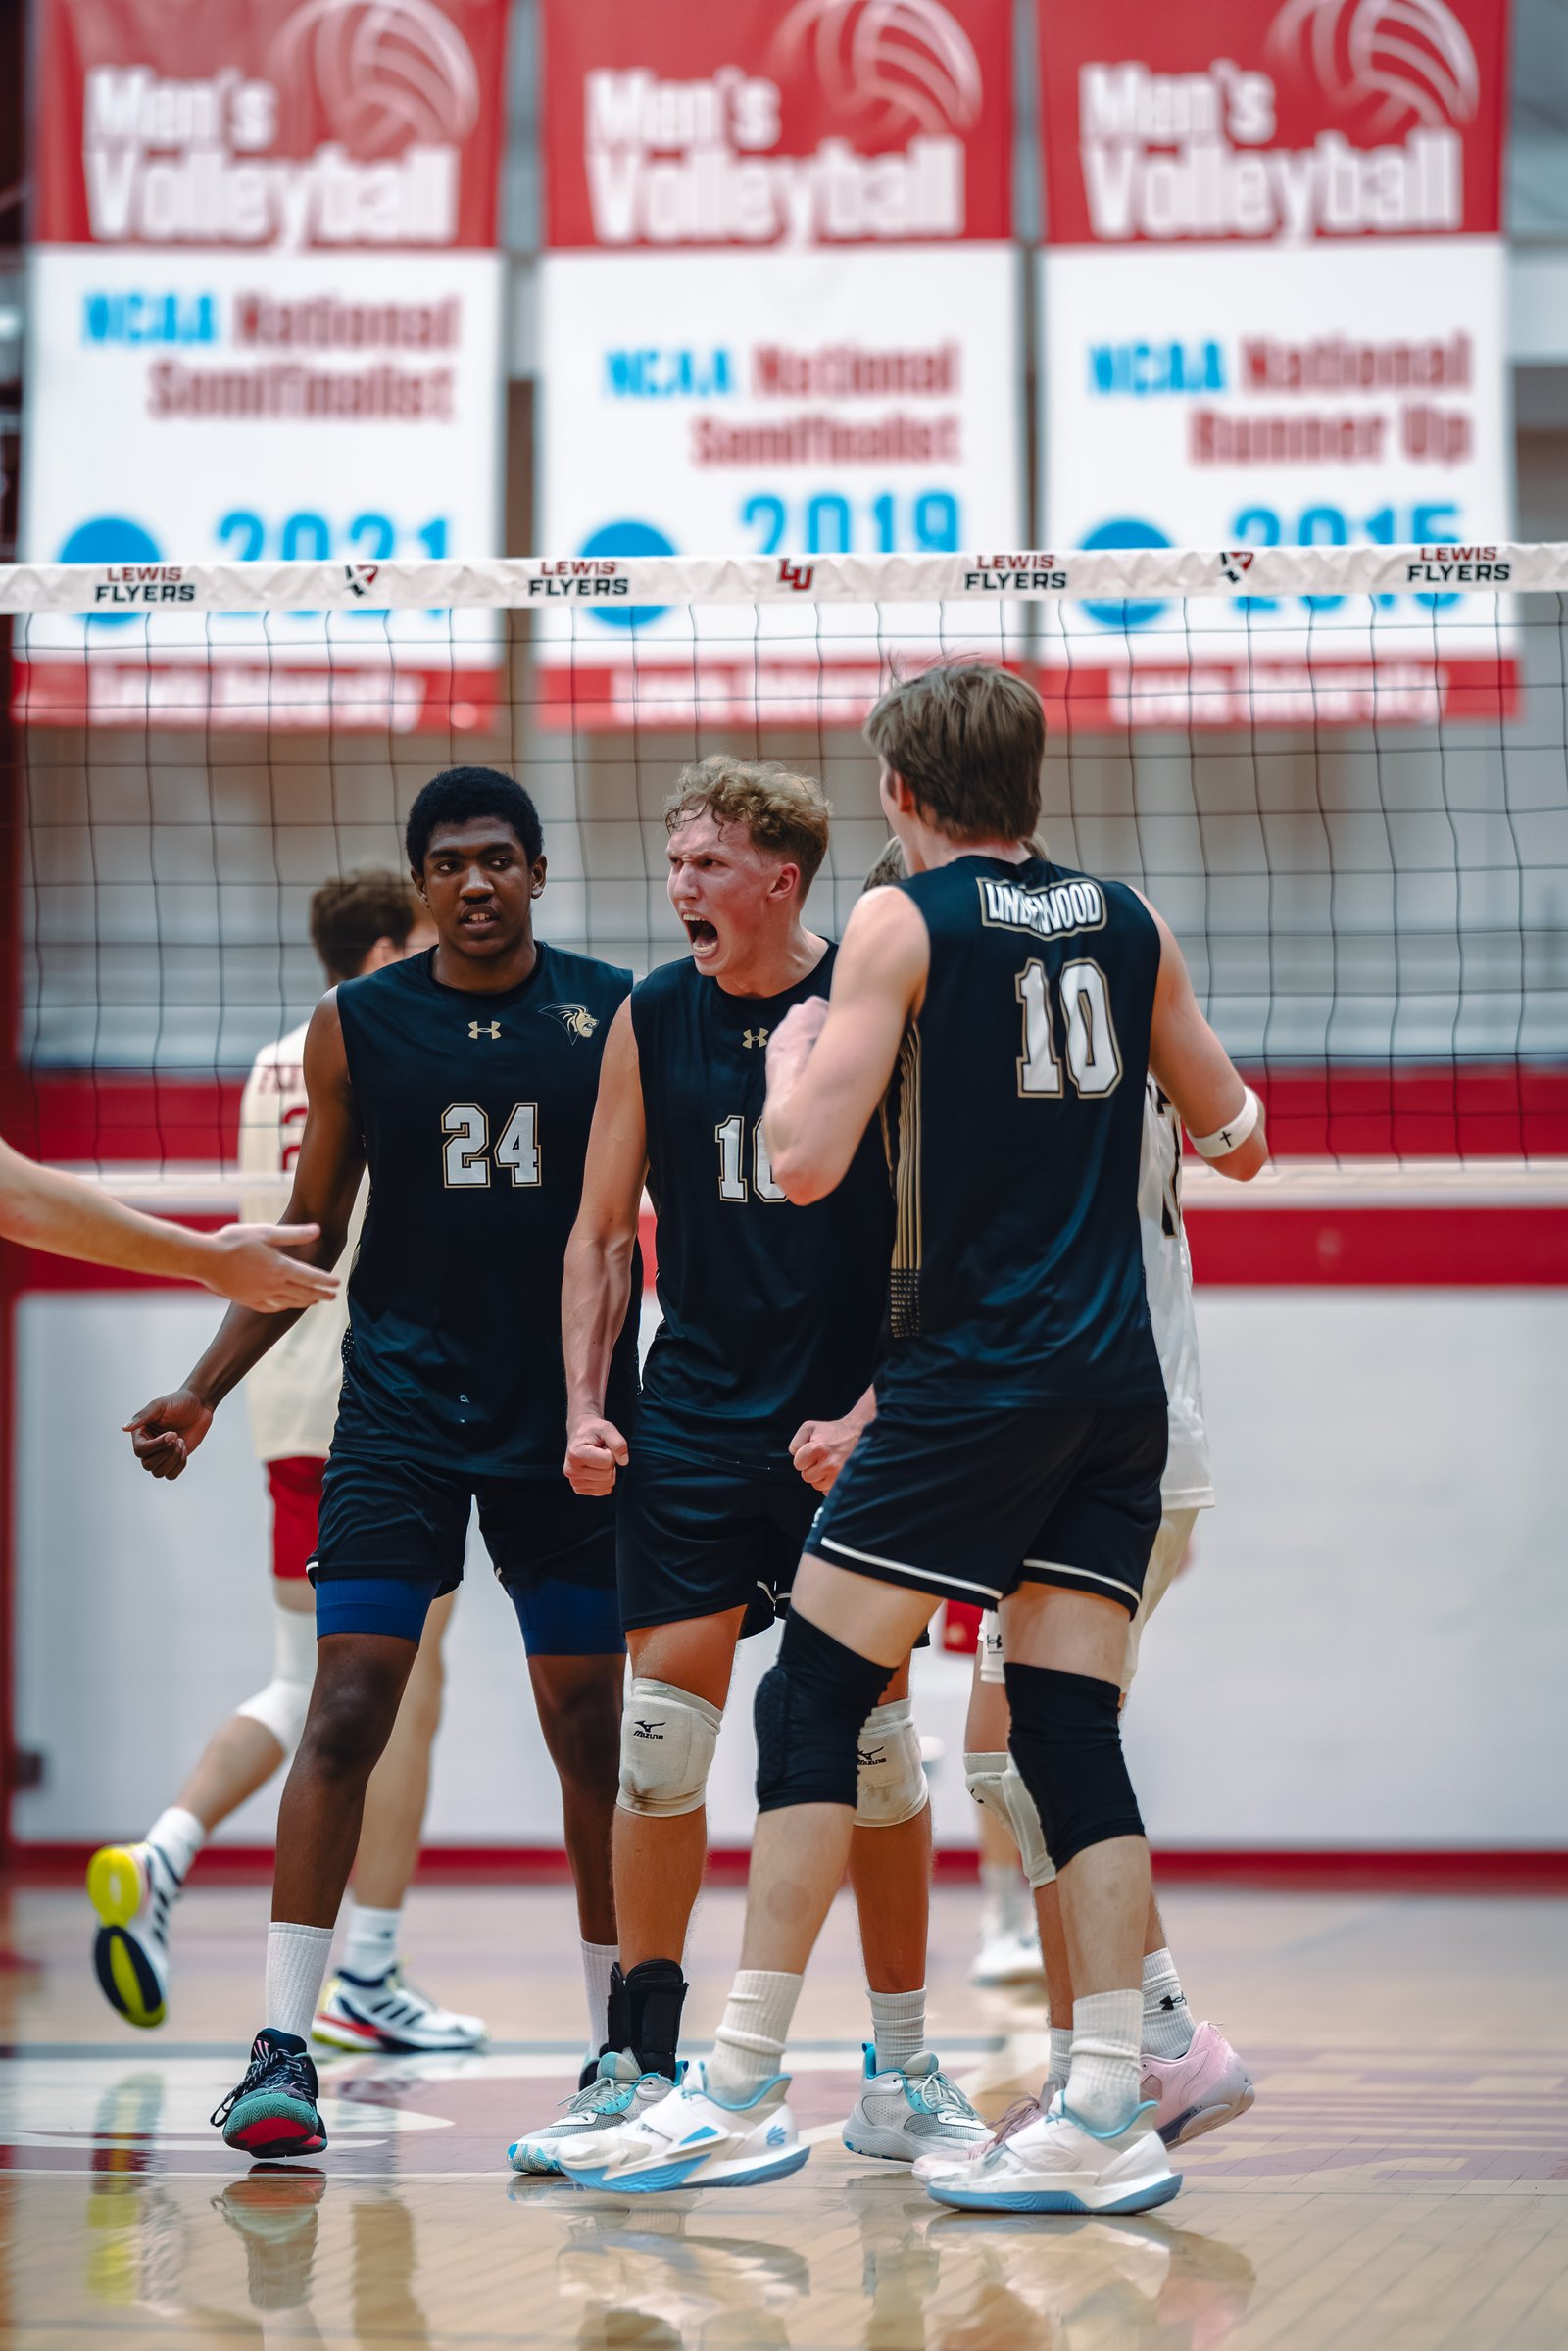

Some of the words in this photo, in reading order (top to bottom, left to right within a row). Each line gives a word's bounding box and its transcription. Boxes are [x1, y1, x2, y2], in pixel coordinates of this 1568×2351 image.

[85, 66, 275, 151] Men's
[586, 66, 782, 150] Men's
[1081, 61, 1274, 144] Men's
[85, 144, 459, 252] Volleyball
[586, 134, 966, 249] Volleyball
[1082, 128, 1462, 246] Volleyball
[82, 293, 218, 347] NCAA
[234, 296, 461, 351] National
[603, 346, 732, 398] NCAA
[752, 341, 960, 397] National
[1089, 339, 1224, 396] NCAA
[1241, 332, 1472, 392] National
[1188, 407, 1383, 466] Runner
[1399, 401, 1472, 468] Up
[107, 565, 182, 582] LEWIS
[540, 561, 617, 576] LEWIS
[777, 558, 815, 592] LU
[964, 572, 1067, 591] FLYERS
[976, 555, 1055, 570] LEWIS
[1406, 564, 1510, 583] FLYERS
[1420, 547, 1497, 563] LEWIS
[95, 585, 196, 603] FLYERS
[527, 578, 629, 597] FLYERS
[1015, 957, 1123, 1099] 10
[441, 1103, 541, 1188] 24
